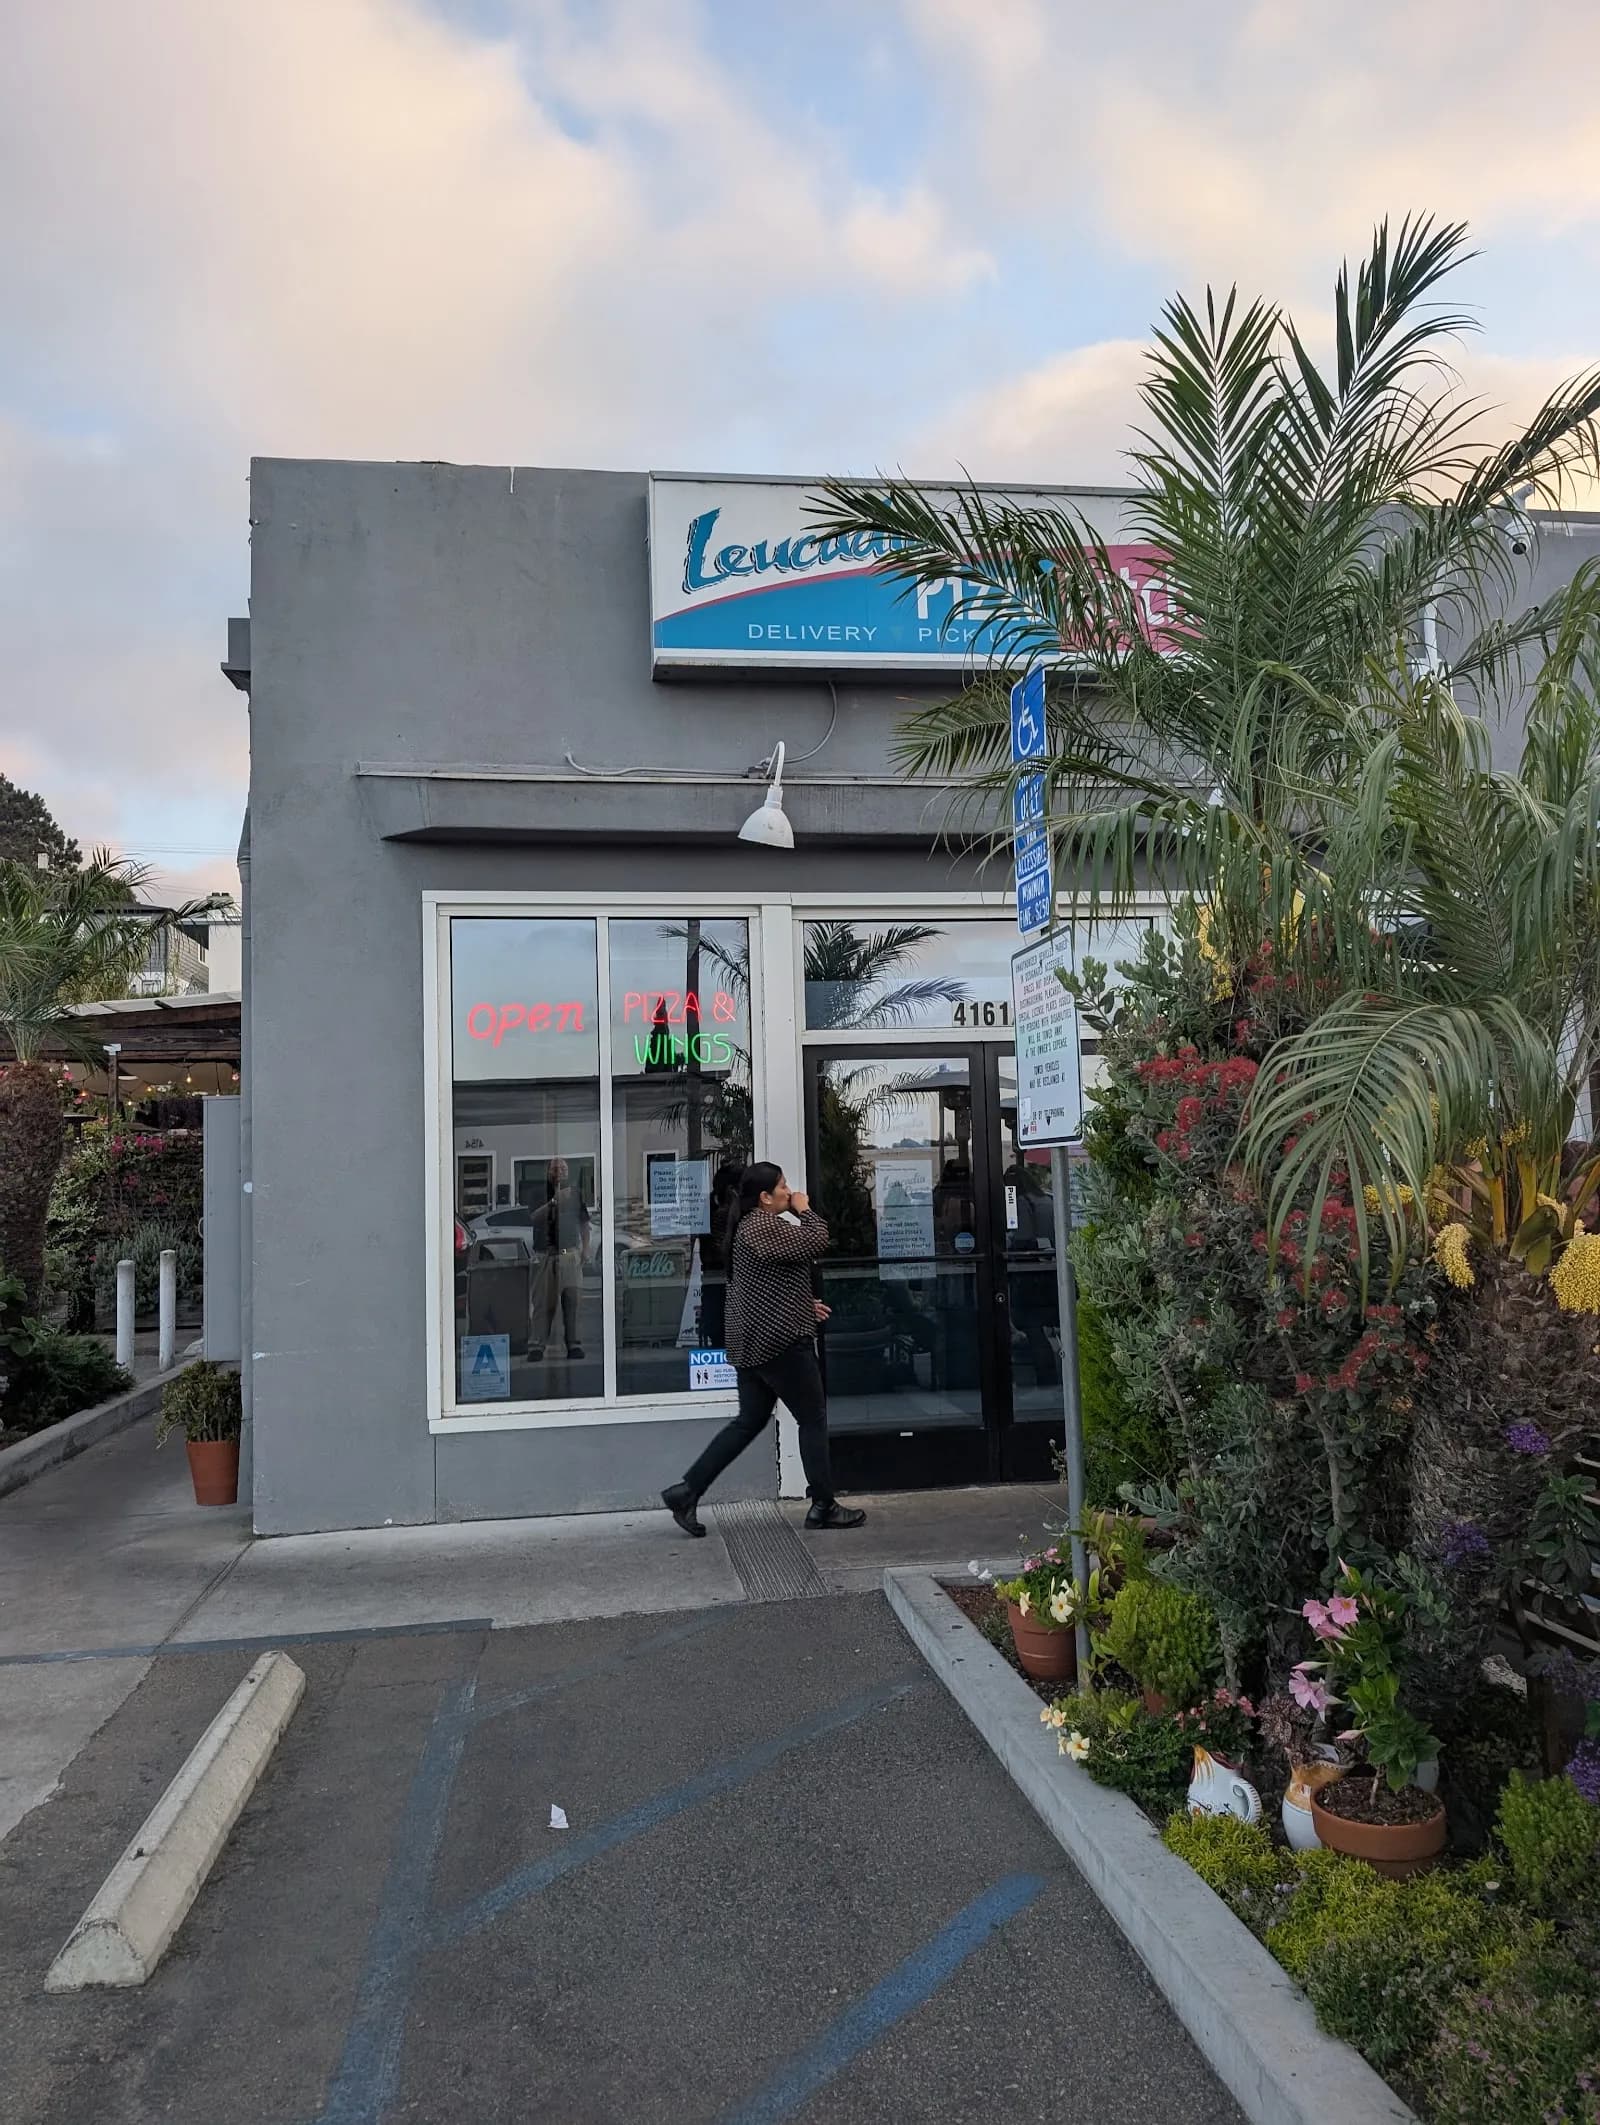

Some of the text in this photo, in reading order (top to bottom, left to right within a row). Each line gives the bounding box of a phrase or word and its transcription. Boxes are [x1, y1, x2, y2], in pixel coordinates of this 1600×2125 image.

[682, 496, 916, 595] Leucad
[748, 624, 877, 641] DELIVERY
[918, 628, 977, 643] PICK
[1018, 842, 1046, 877] ACCESSIBLE
[1022, 873, 1045, 904] MINIMUM
[1020, 906, 1032, 928] FINE
[624, 991, 736, 1025] PIZZA &
[954, 1001, 1015, 1026] 4161
[634, 1033, 732, 1065] WINGS
[628, 1252, 675, 1277] hello
[472, 1344, 500, 1376] A
[690, 1352, 729, 1365] NOTI
